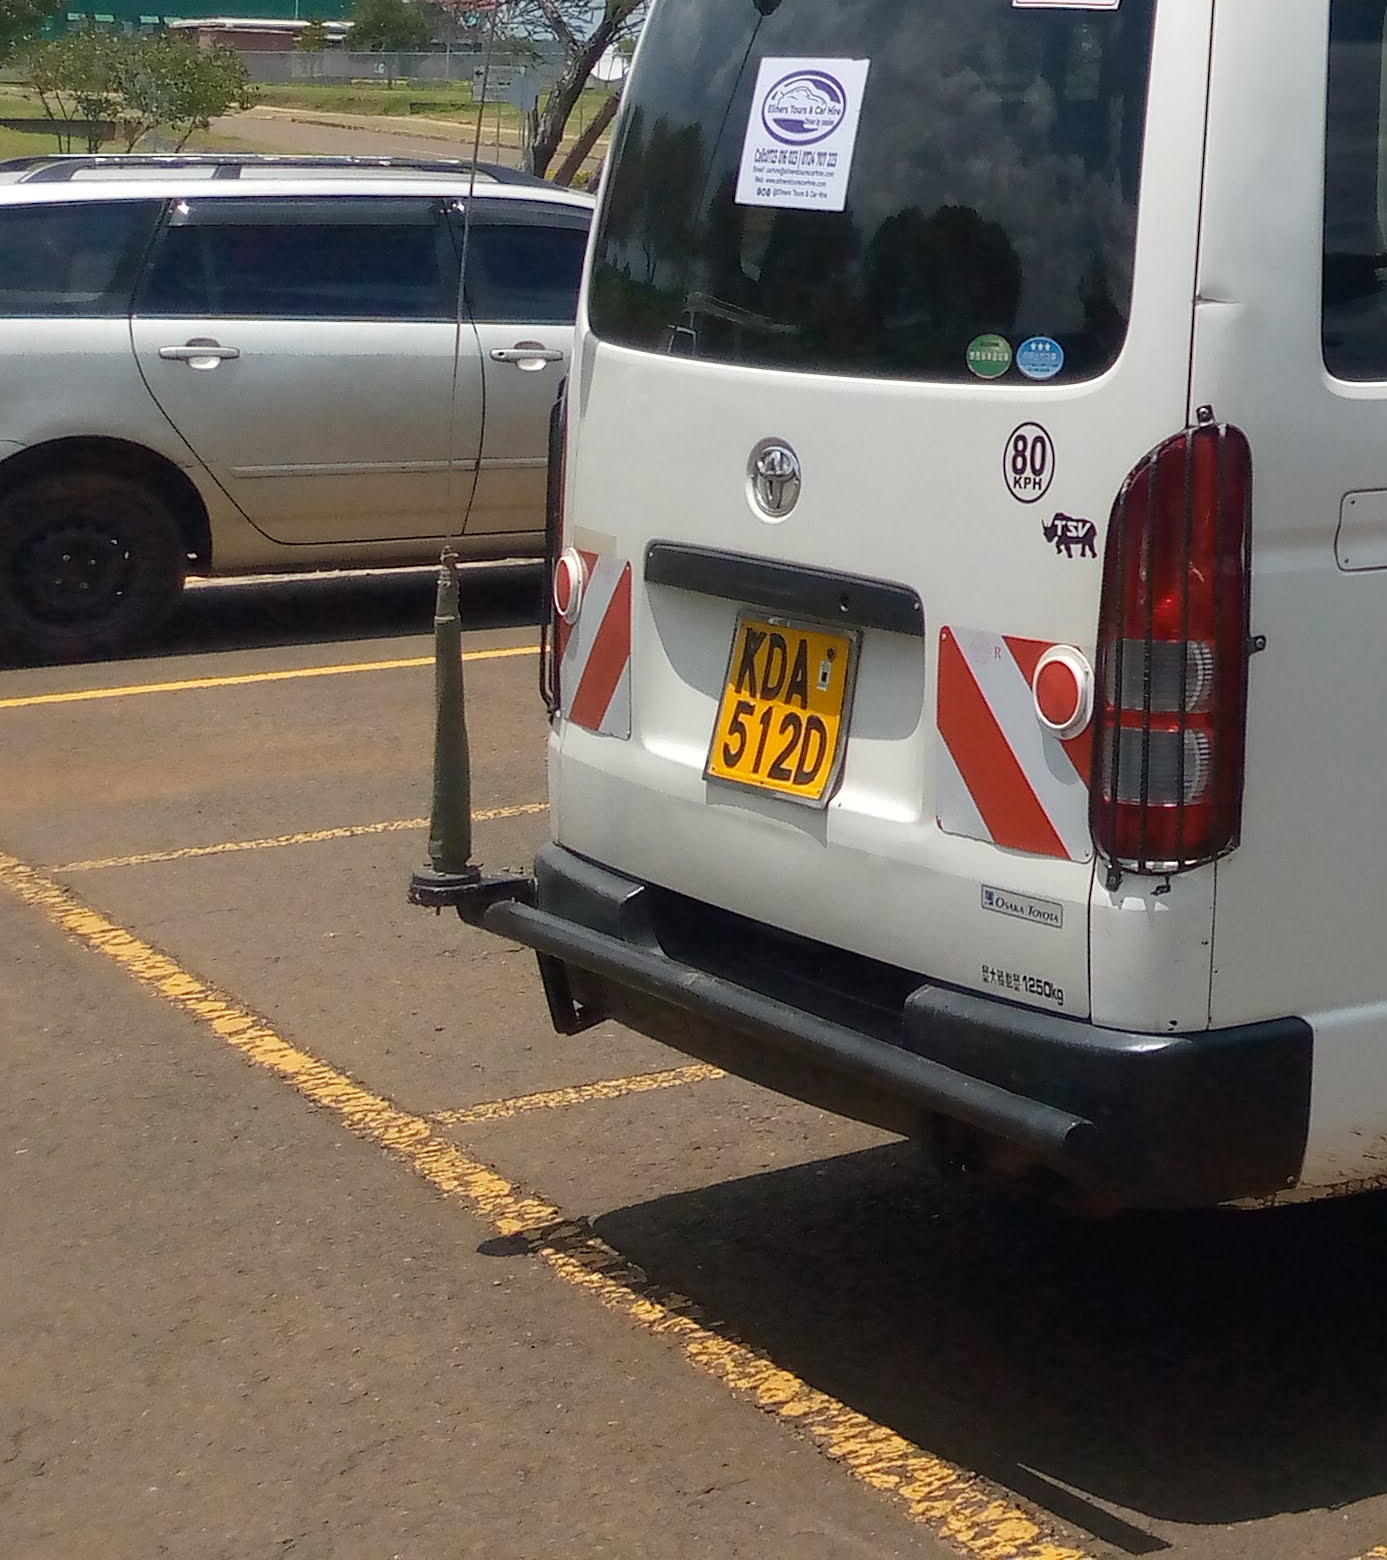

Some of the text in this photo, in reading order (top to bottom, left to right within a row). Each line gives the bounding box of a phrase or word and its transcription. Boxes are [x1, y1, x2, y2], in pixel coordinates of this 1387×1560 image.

[790, 105, 807, 115] Tours
[815, 105, 826, 115] Car
[827, 106, 841, 116] Hire
[1011, 434, 1047, 477] 80
[1013, 476, 1043, 491] KPH
[1054, 520, 1092, 538] TSV
[735, 626, 809, 710] KDA
[722, 699, 829, 786] 512D
[995, 896, 1059, 923] OSAKA TOYOTA
[1022, 975, 1064, 1006] 1250kg
